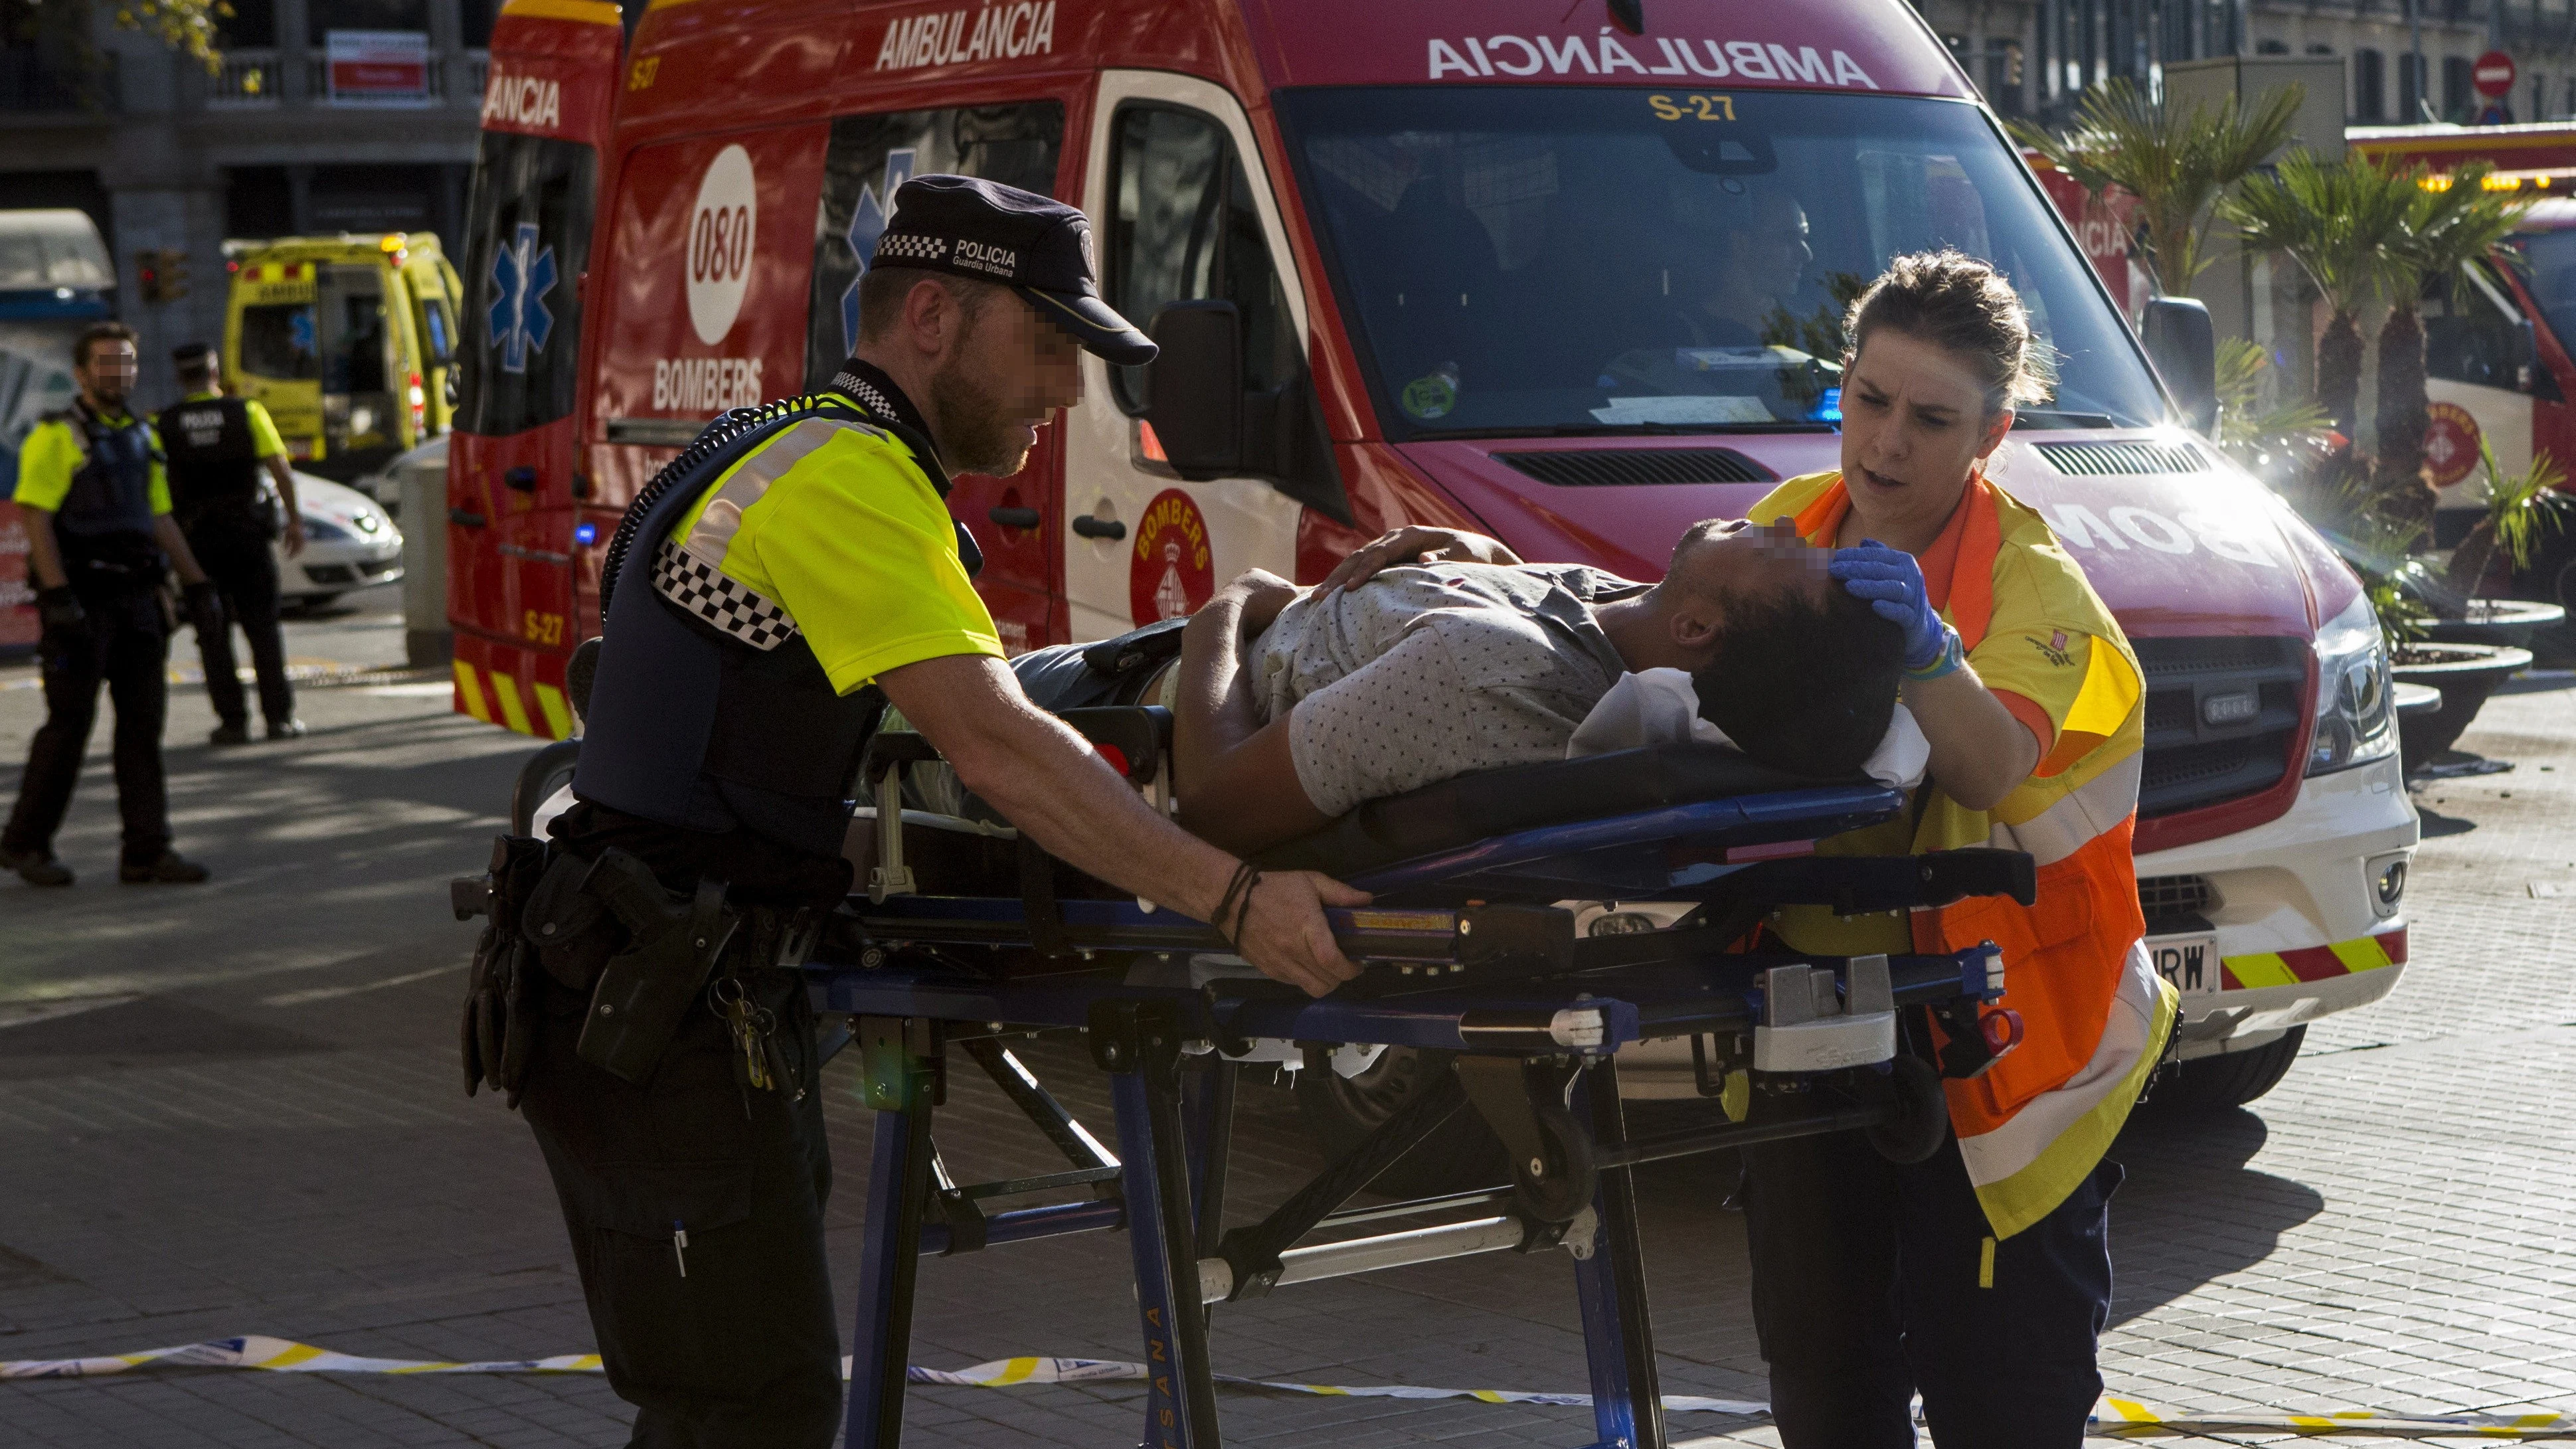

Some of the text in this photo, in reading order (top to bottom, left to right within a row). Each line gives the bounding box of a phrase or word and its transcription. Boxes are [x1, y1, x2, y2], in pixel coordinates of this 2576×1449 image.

[1648, 94, 1737, 122] S-27
[694, 205, 749, 284] 080
[955, 240, 1016, 268] POLICIA
[952, 256, 1014, 278] Guàrdia Urbana
[653, 356, 763, 412] BOMBERS
[1137, 499, 1209, 571] BOMBERS
